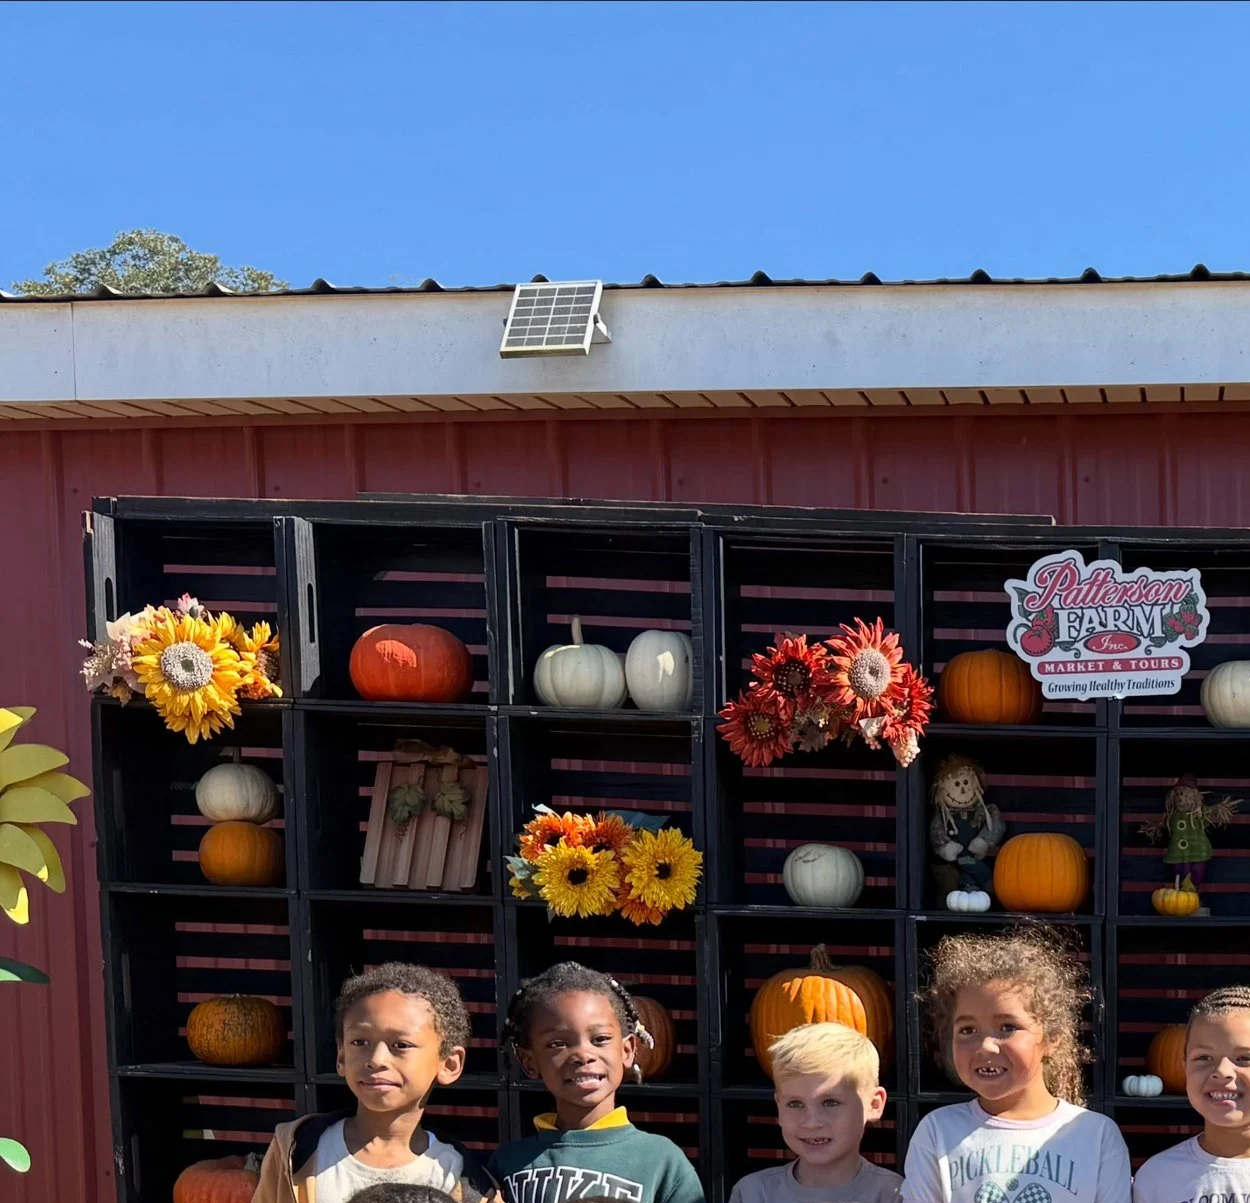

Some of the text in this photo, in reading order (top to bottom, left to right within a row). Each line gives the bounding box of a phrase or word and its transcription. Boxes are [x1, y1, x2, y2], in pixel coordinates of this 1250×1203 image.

[1024, 558, 1192, 611] Patterson
[1054, 604, 1166, 641] FARM
[1092, 634, 1128, 651] Inc.
[1044, 658, 1180, 673] MARKET & TOURS
[1048, 678, 1175, 694] Growing Healthy Traditions
[949, 1144, 1078, 1196] PICKLEBALL
